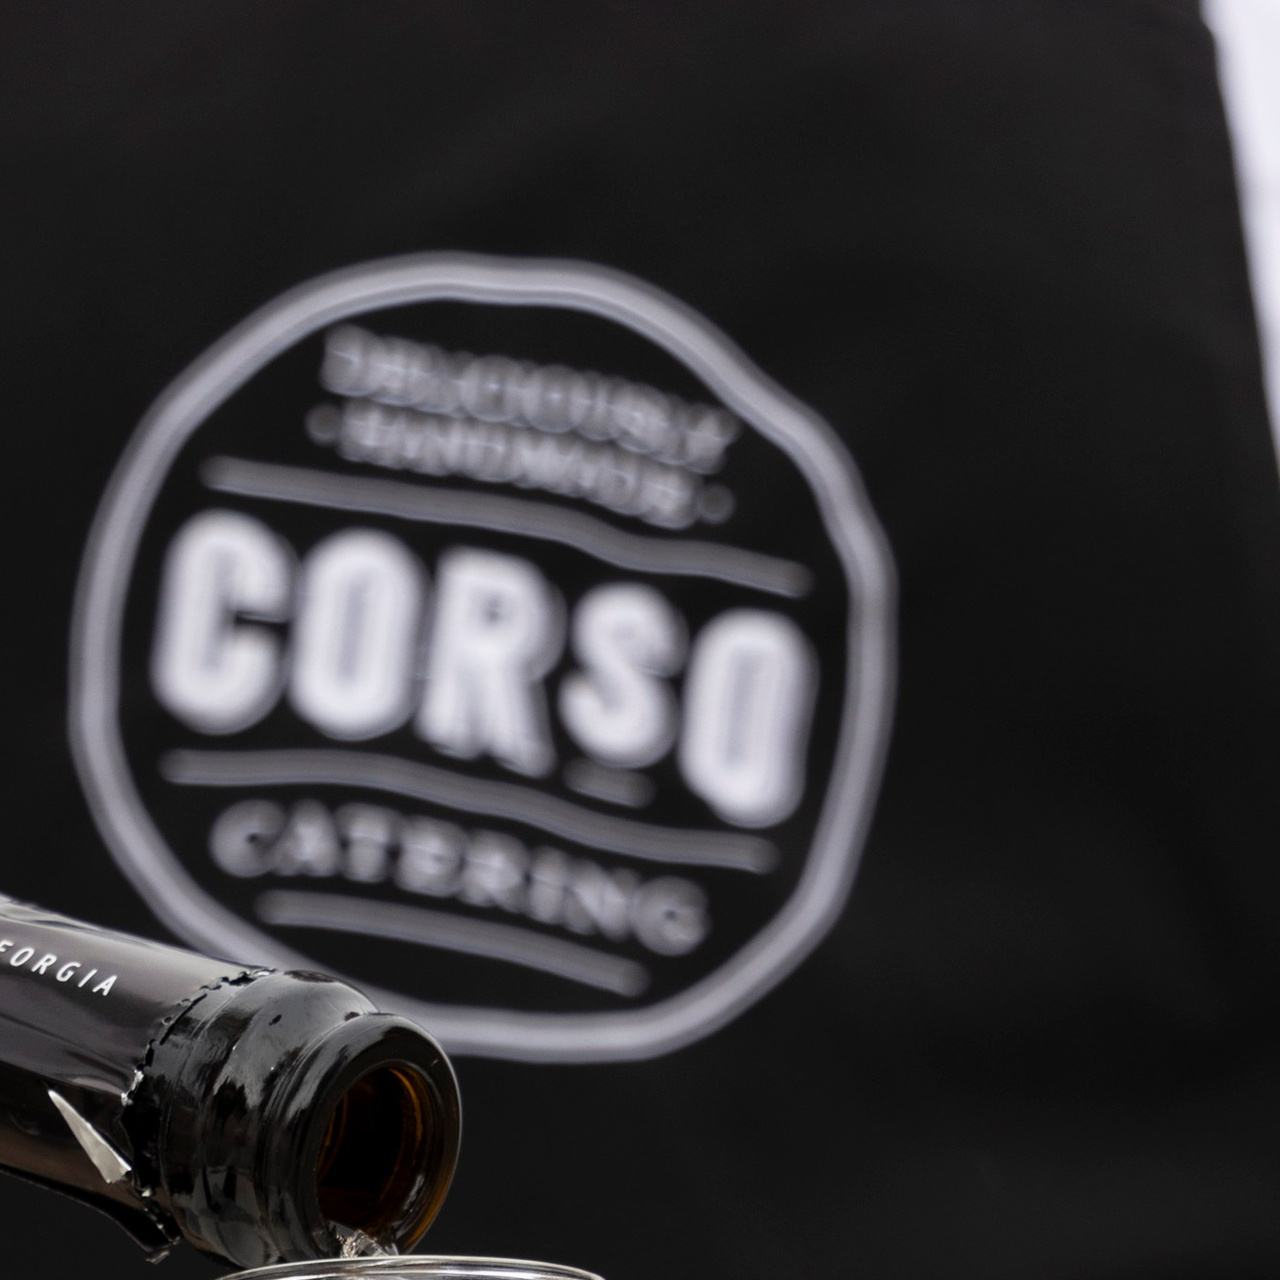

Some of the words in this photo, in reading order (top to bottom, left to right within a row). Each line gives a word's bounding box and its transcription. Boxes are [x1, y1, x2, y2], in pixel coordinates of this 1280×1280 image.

[322, 326, 740, 474] DELICIOUSLY
[152, 509, 818, 827] CORSO
[210, 800, 708, 956] CATERING
